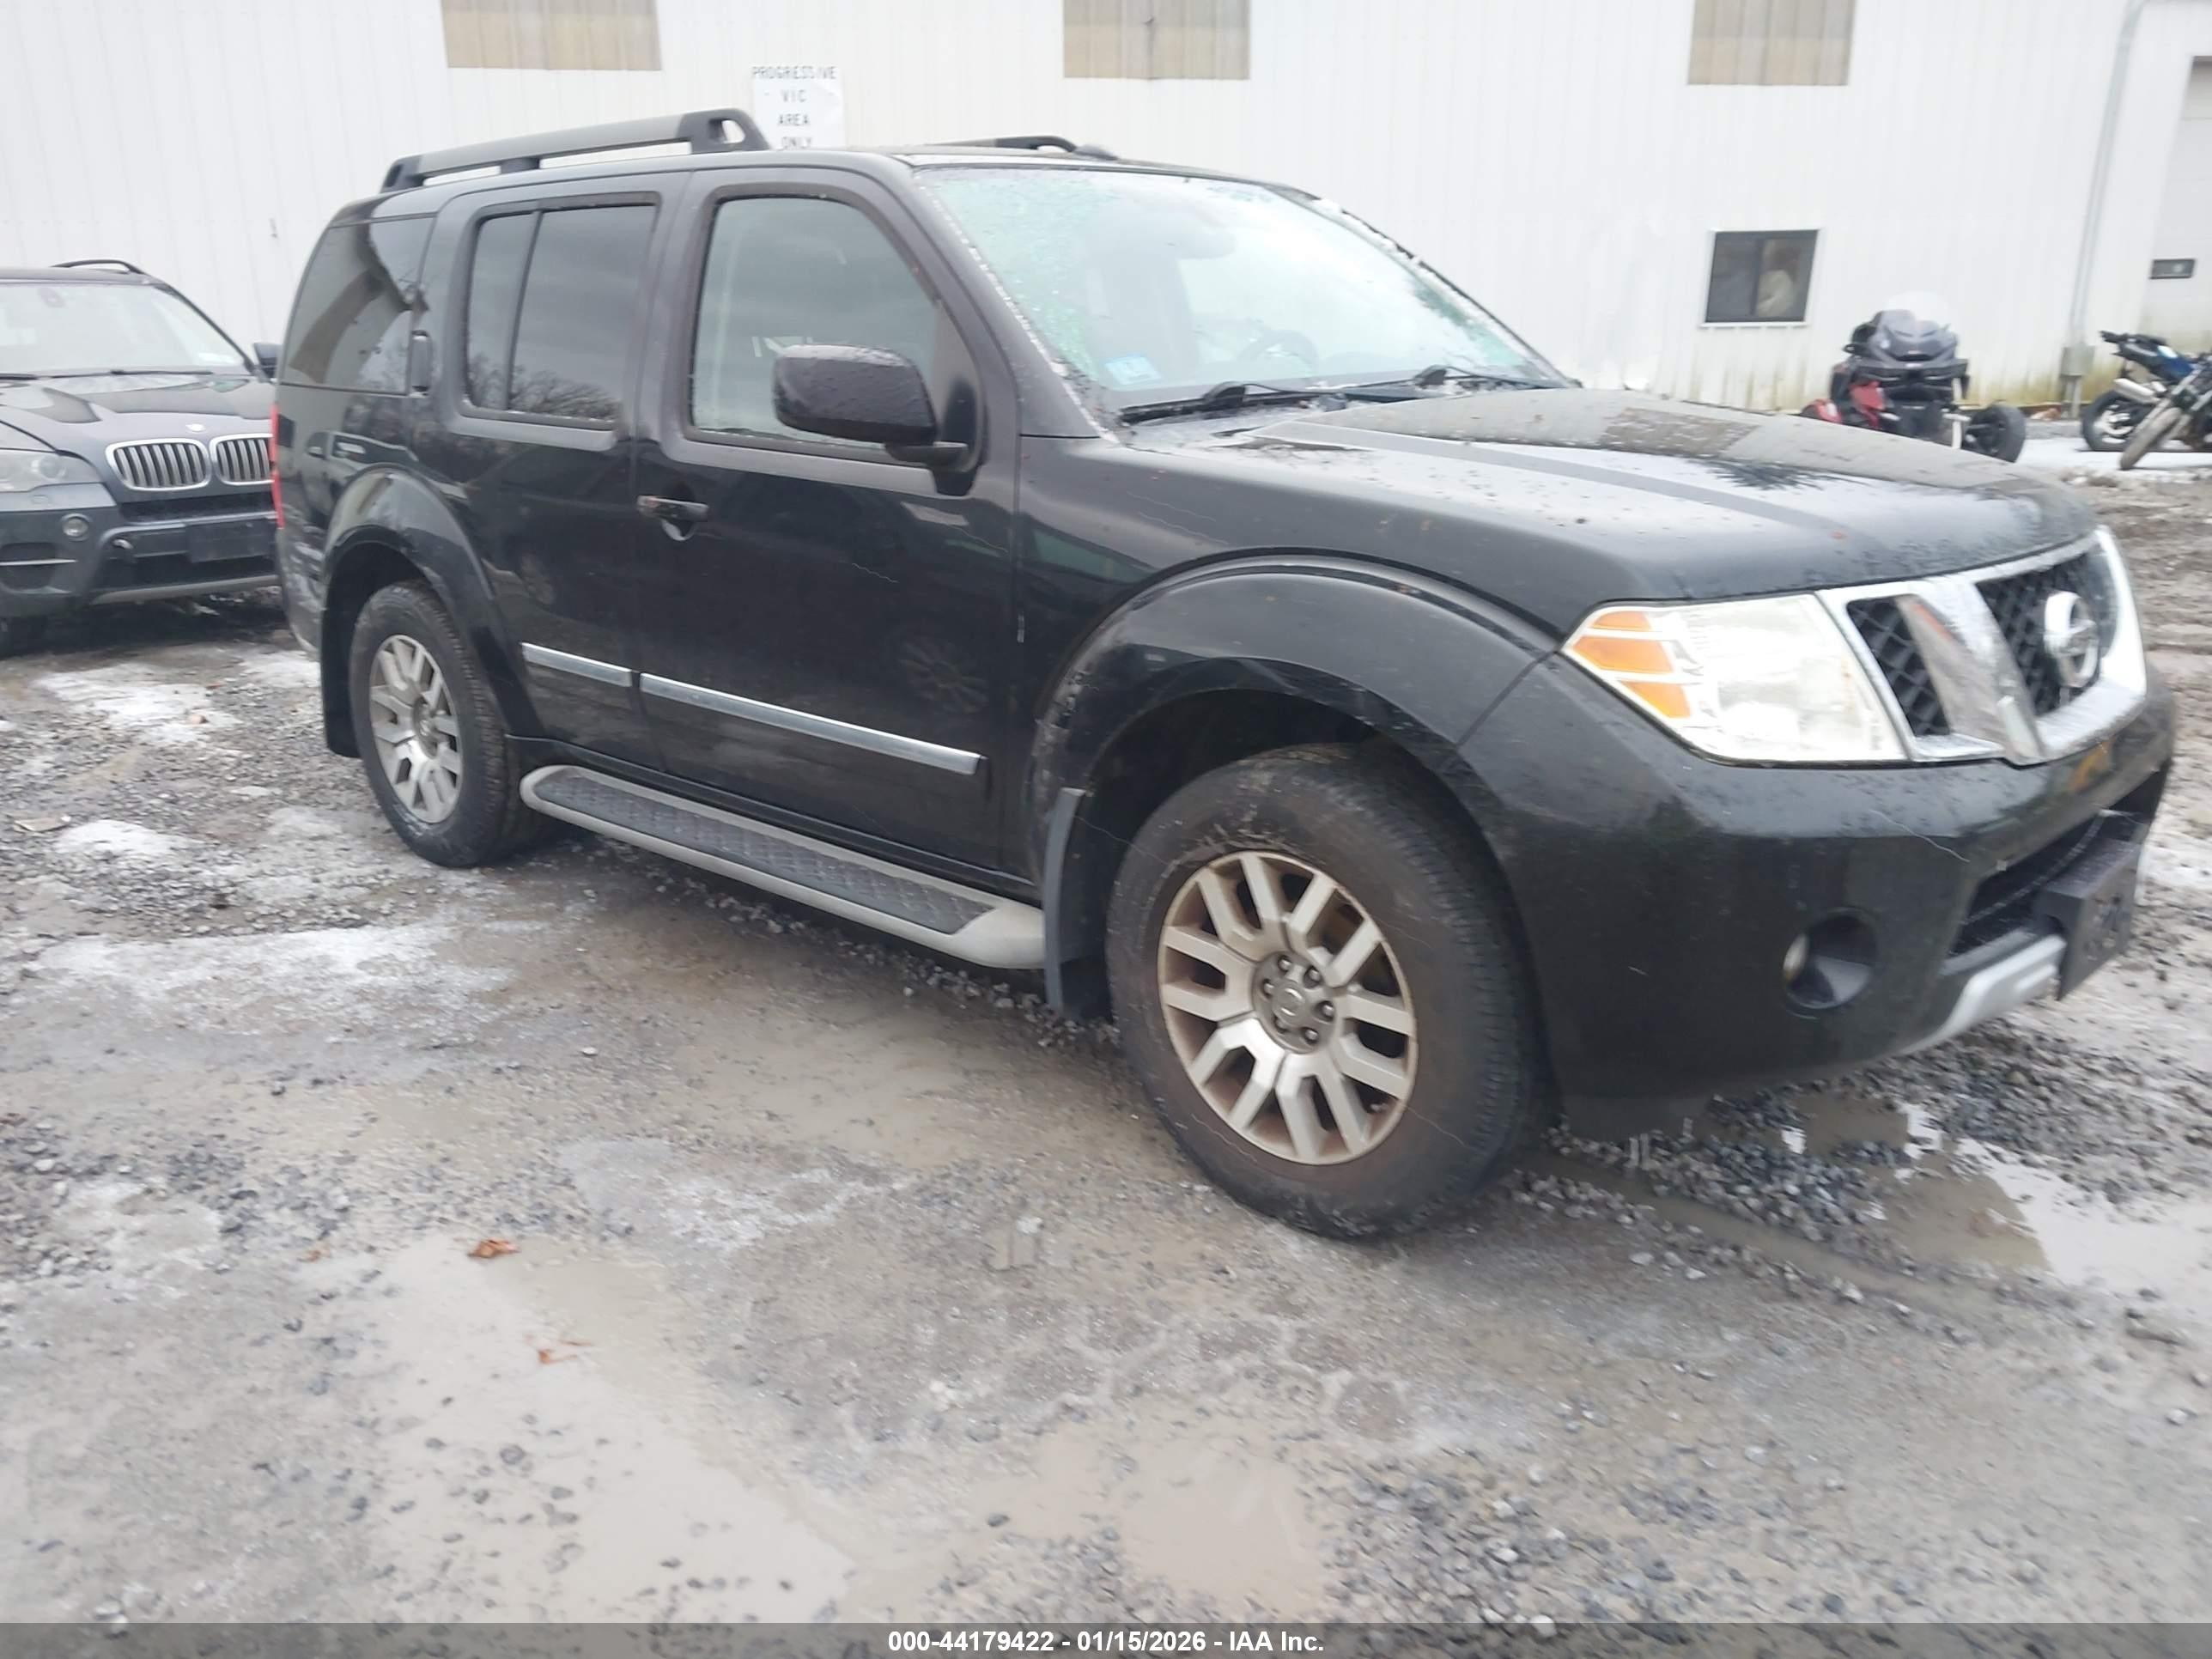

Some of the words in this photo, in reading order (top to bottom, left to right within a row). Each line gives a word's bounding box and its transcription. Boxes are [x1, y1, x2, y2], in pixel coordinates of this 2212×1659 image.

[752, 65, 837, 79] PROGRESSIVE
[781, 89, 807, 102] VIC
[778, 113, 810, 126] AREA
